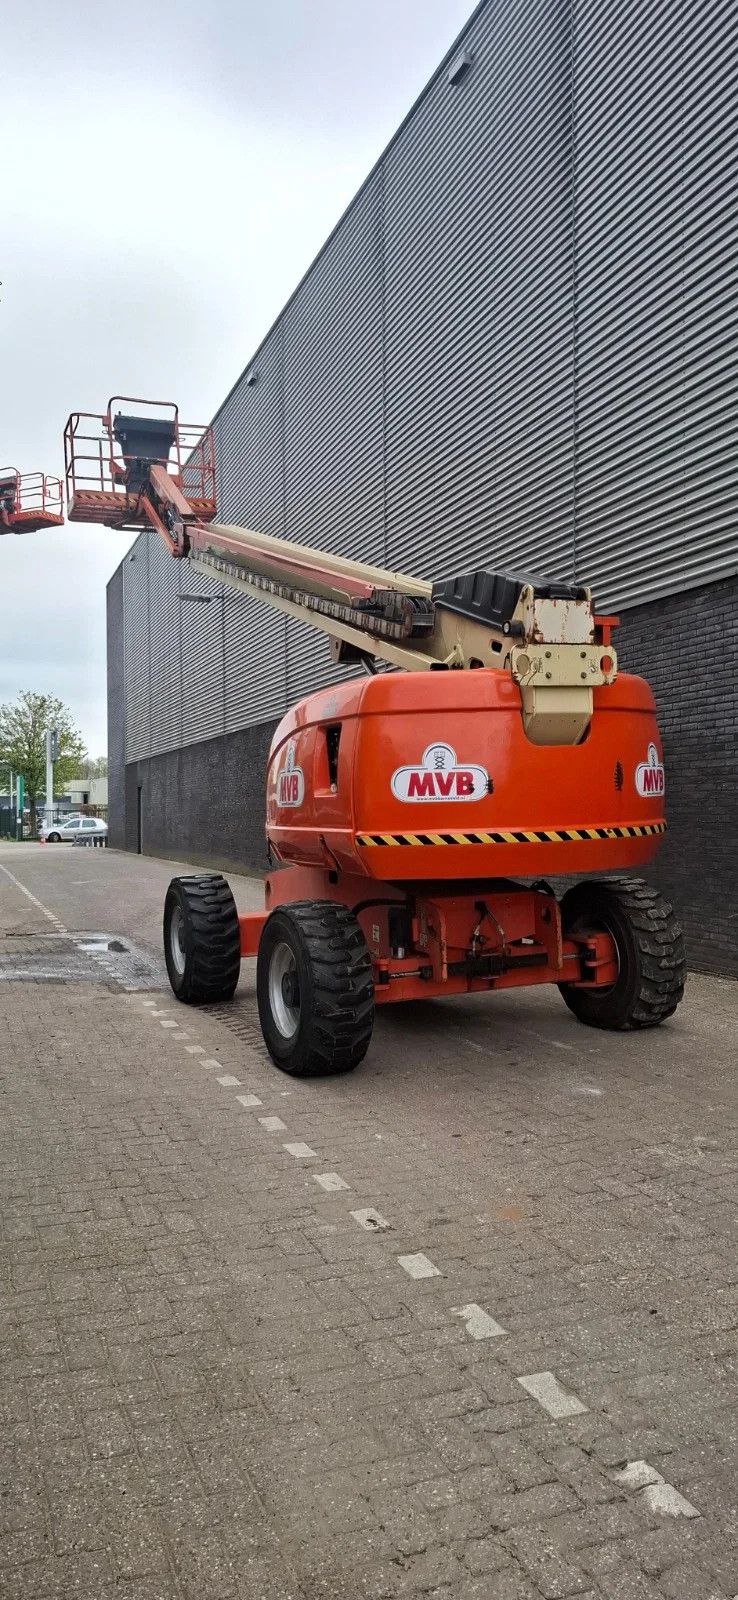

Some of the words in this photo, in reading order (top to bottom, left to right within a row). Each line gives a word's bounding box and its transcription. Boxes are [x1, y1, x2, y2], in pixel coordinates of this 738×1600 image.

[280, 774, 299, 802] MVB
[407, 771, 475, 798] MVB
[643, 769, 664, 791] MVB
